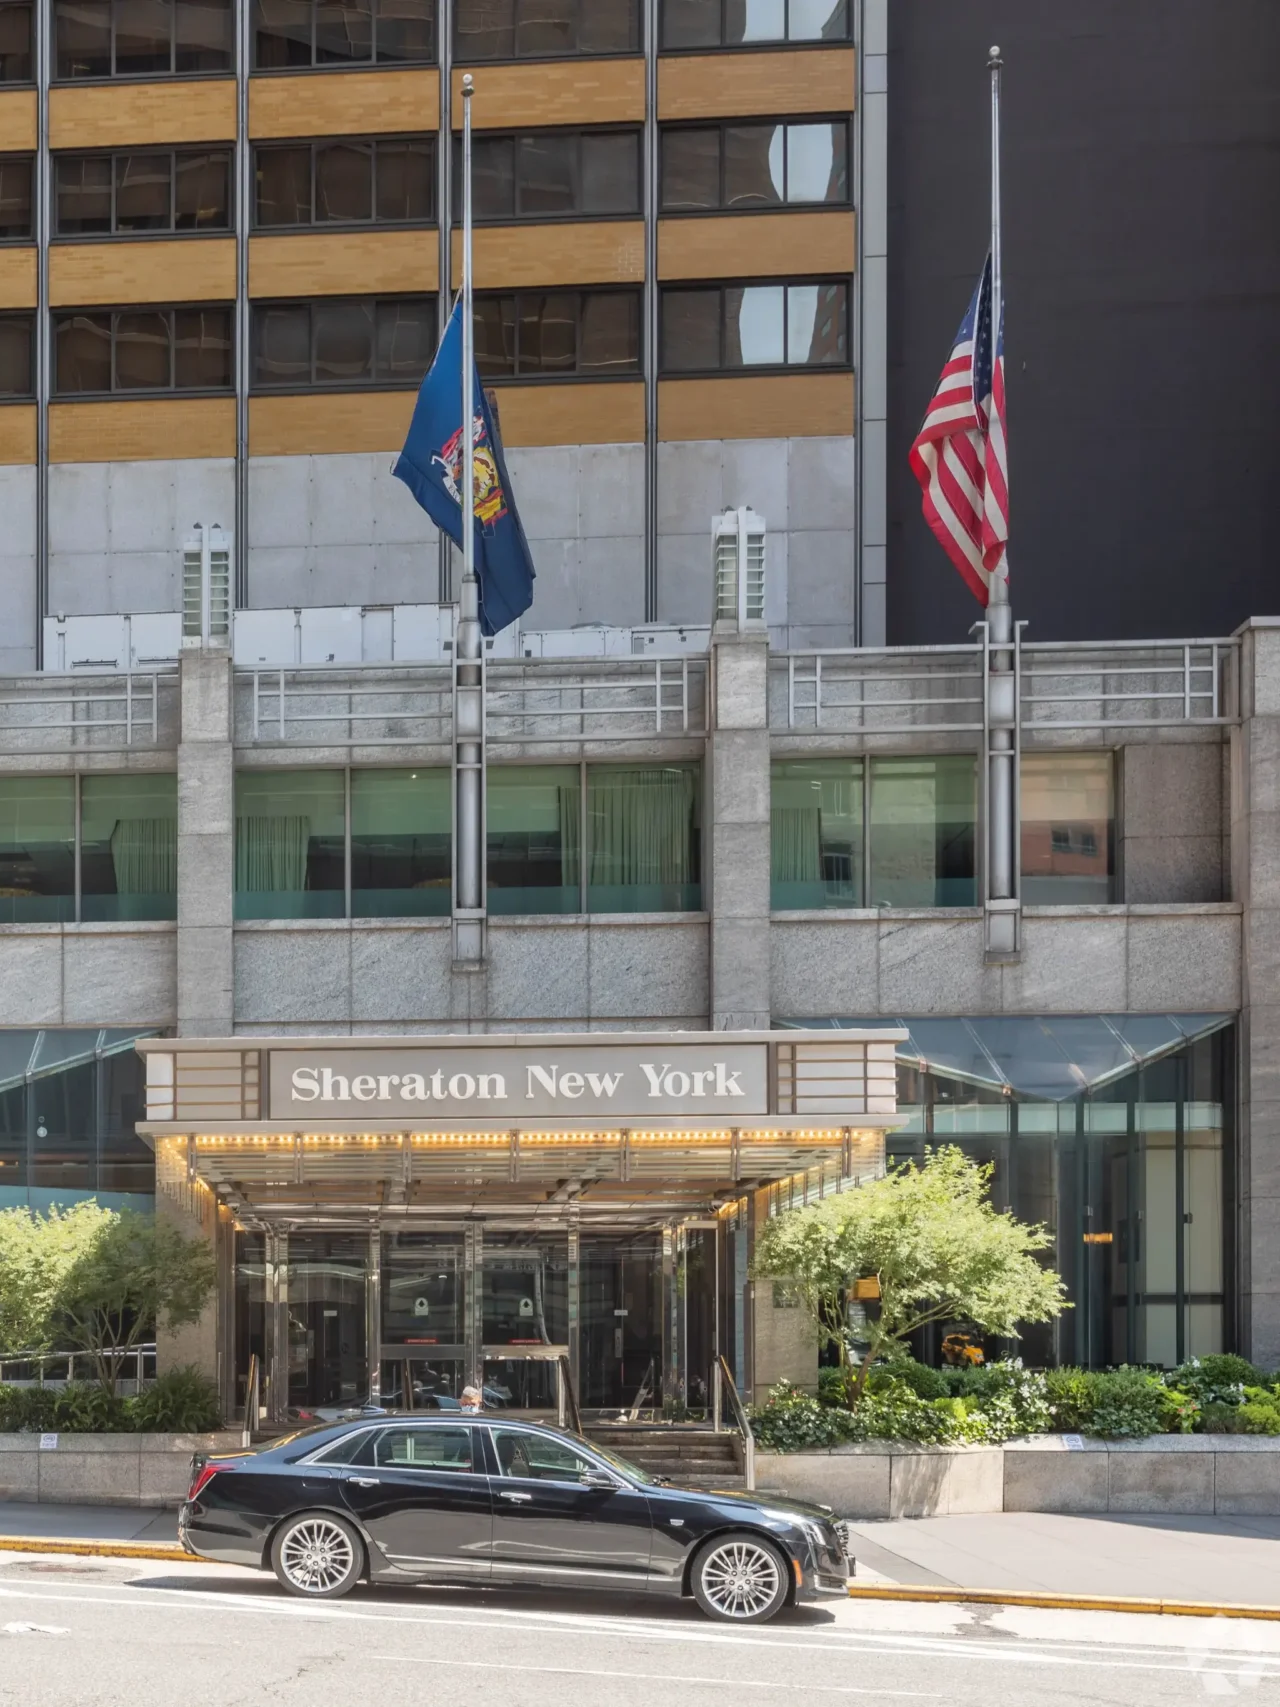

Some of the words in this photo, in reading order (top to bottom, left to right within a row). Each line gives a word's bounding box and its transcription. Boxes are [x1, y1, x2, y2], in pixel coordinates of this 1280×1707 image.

[291, 1067, 508, 1101] Sheraton
[525, 1064, 624, 1099] New
[640, 1062, 745, 1097] York
